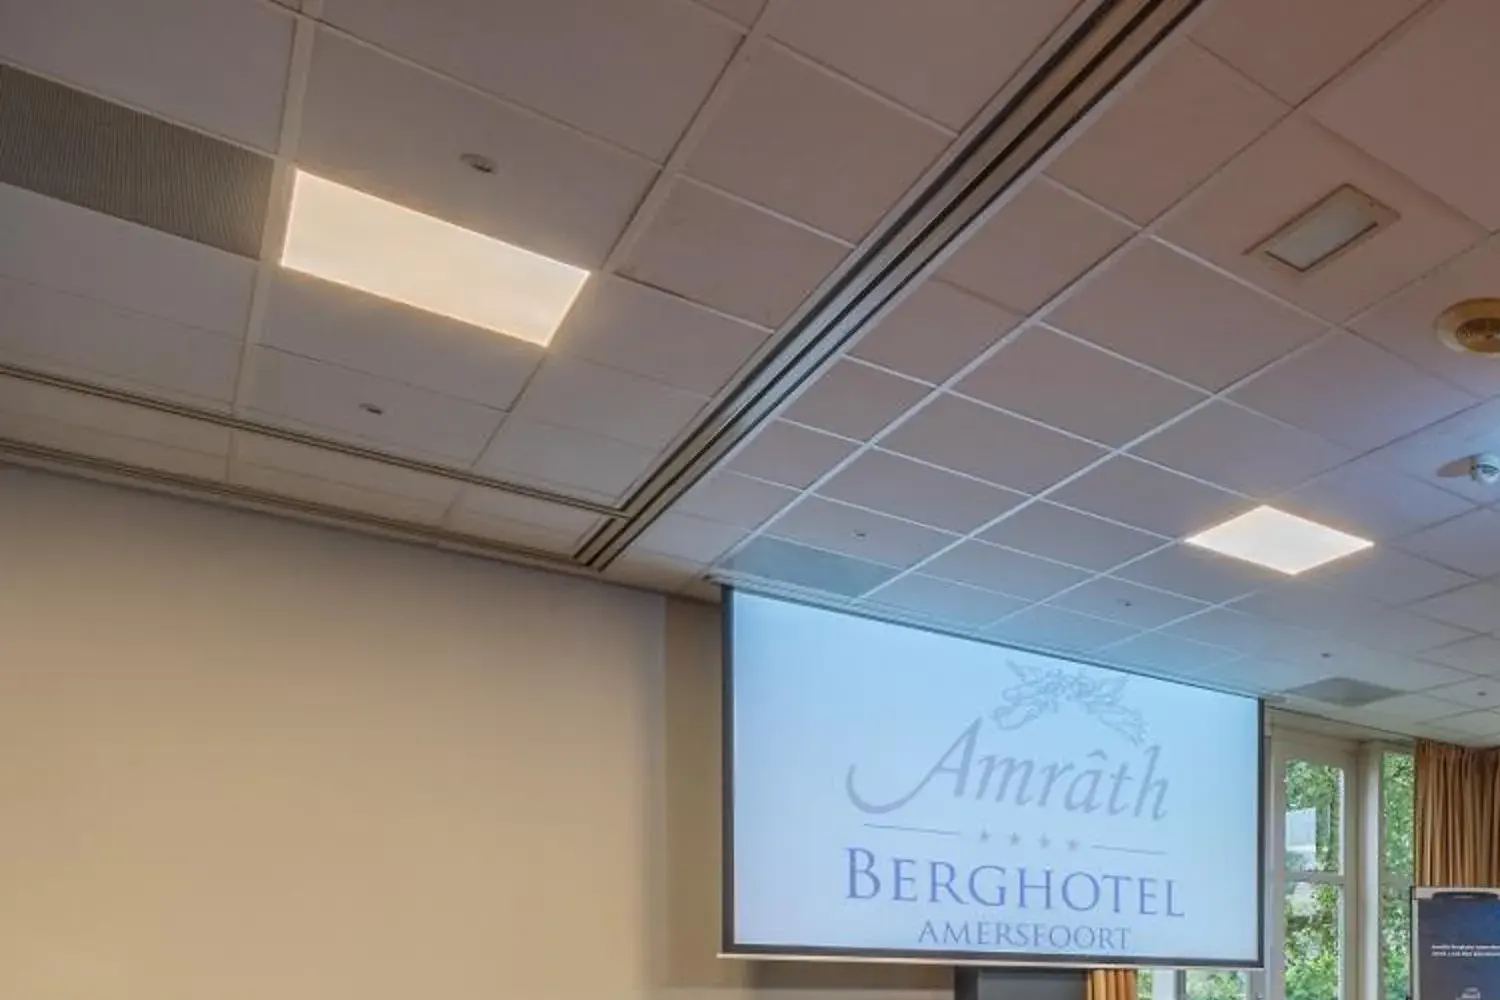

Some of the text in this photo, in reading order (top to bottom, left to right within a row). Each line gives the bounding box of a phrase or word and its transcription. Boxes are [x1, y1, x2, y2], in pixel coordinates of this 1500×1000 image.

[847, 718, 1169, 821] Amrâth
[846, 848, 1185, 918] BERGHOTEL
[918, 920, 1131, 951] AMERSFOORT
